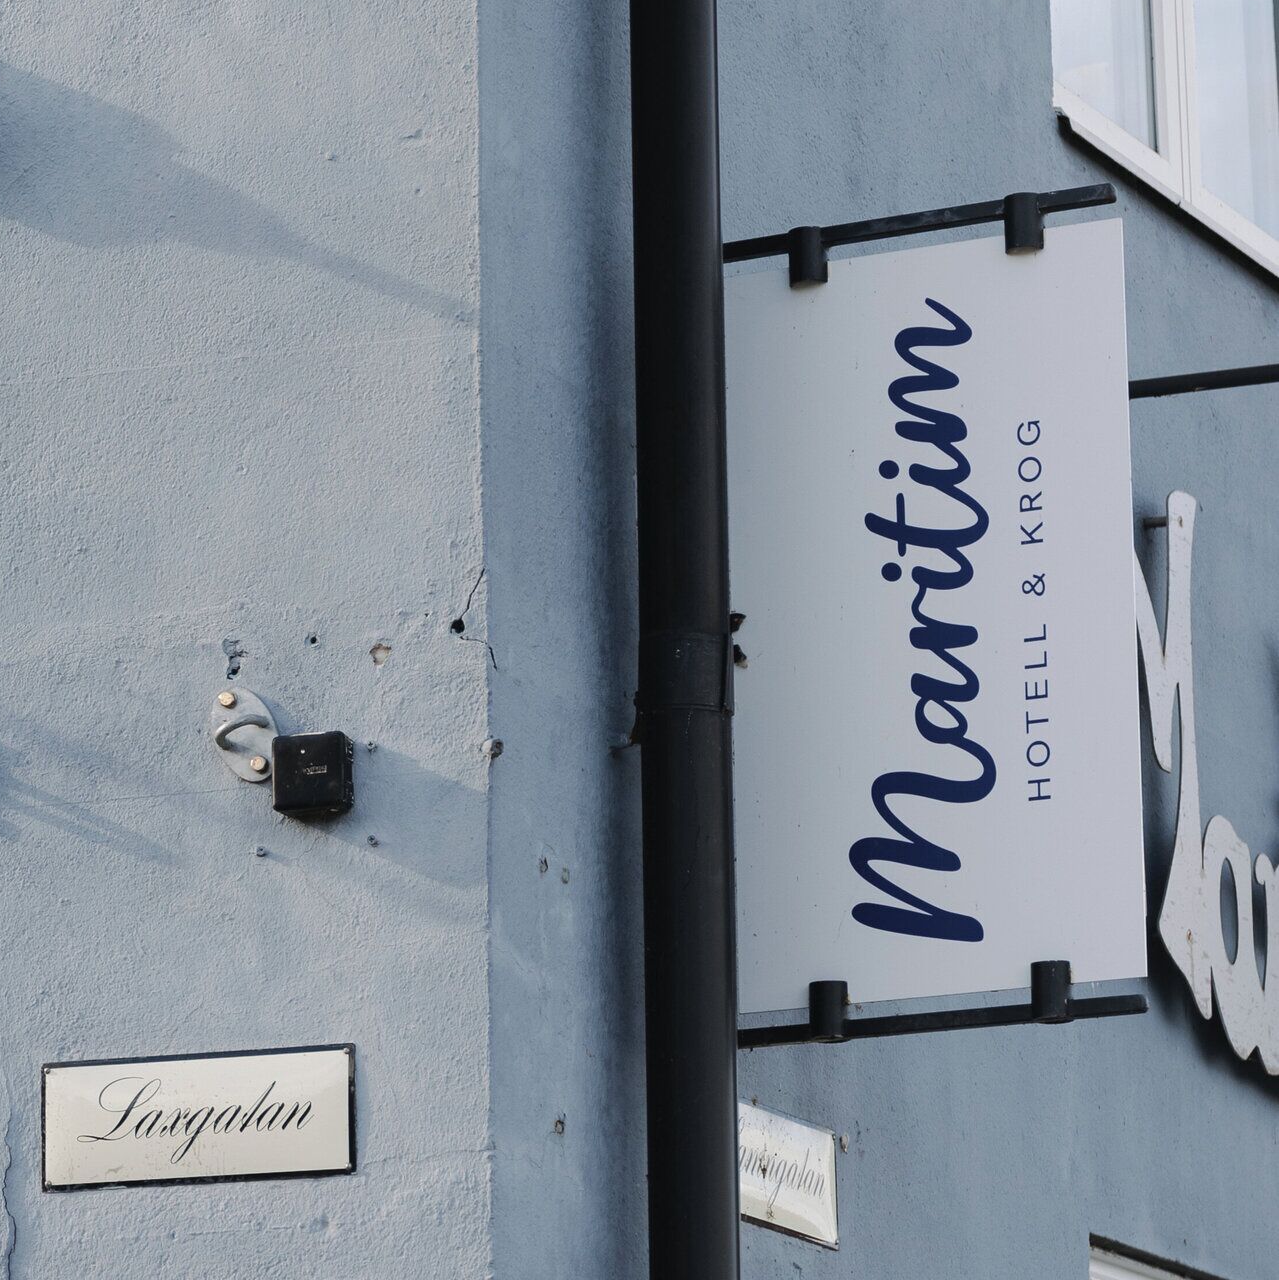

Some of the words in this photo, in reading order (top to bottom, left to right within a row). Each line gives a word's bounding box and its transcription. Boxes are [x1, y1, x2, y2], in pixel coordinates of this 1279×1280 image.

[1017, 421, 1043, 545] KROG
[849, 298, 996, 942] Maritim
[1022, 574, 1045, 596] &
[1024, 624, 1051, 801] HOTELL
[76, 1075, 316, 1165] Laxgatan
